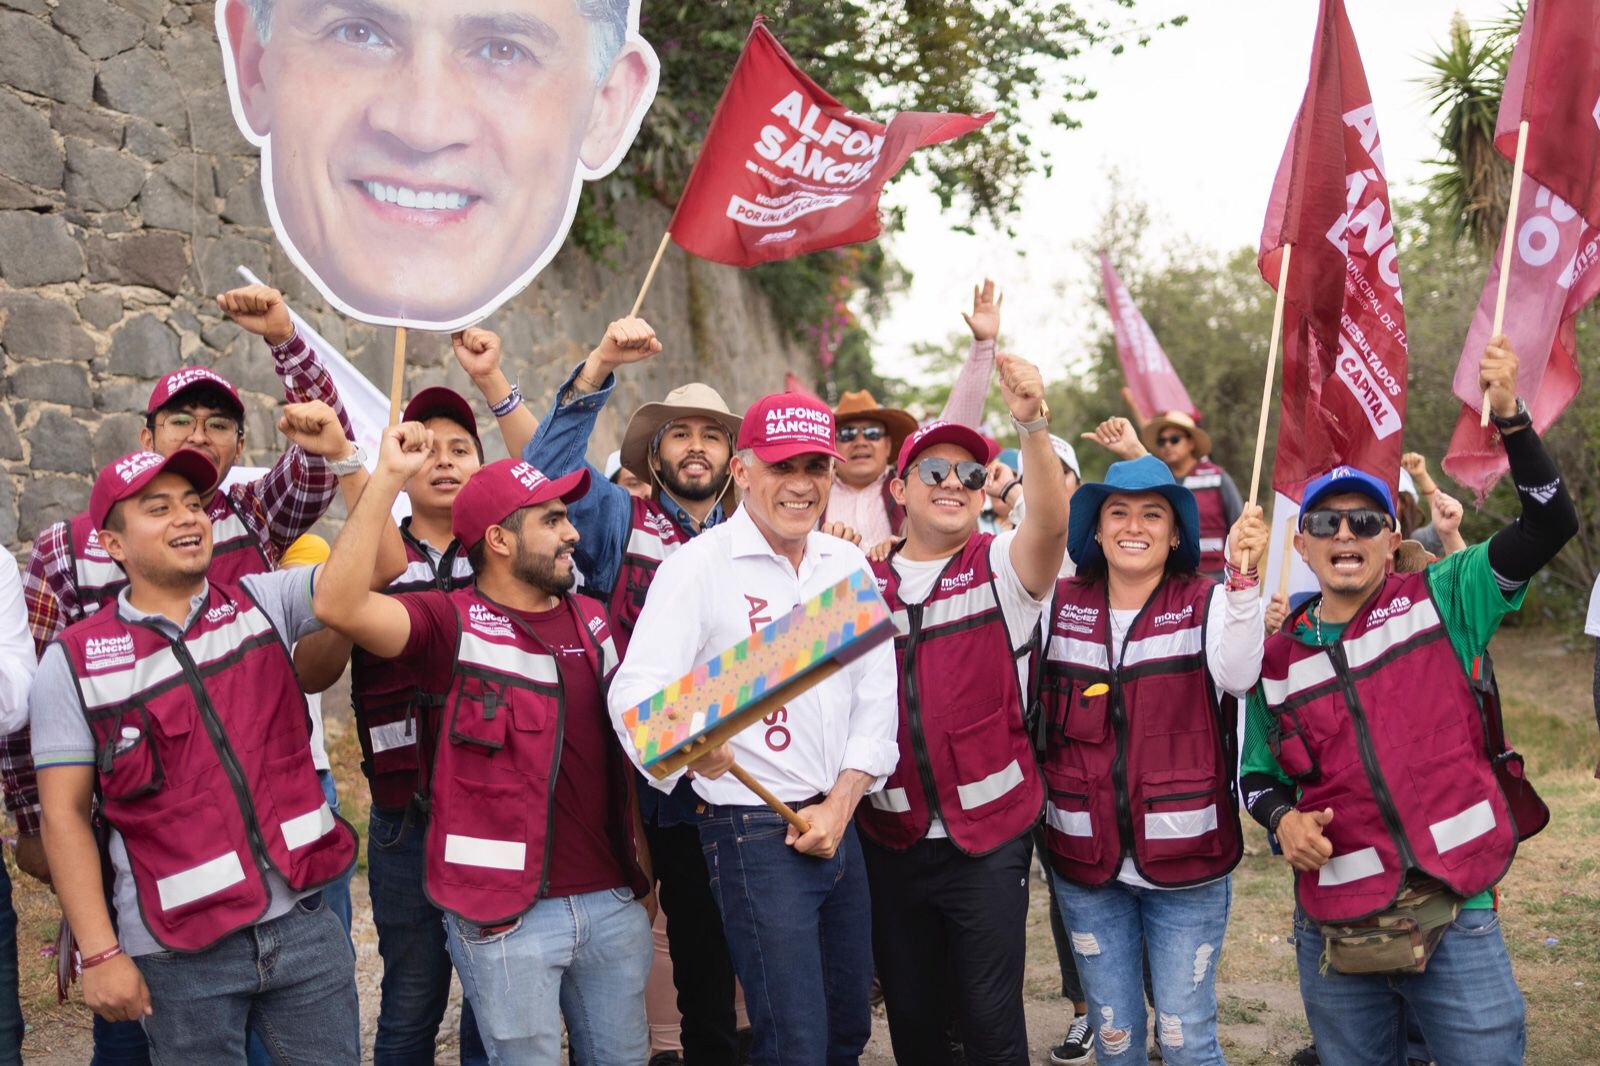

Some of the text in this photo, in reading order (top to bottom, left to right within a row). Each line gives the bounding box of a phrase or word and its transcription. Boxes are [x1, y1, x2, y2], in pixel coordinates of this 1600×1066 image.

[736, 204, 762, 221] POR
[1380, 313, 1397, 333] DE
[1341, 313, 1402, 396] RESULTADOS
[1341, 357, 1391, 426] CAPITAL
[765, 408, 831, 425] ALFONSO
[765, 419, 832, 439] SÁNCHEZ
